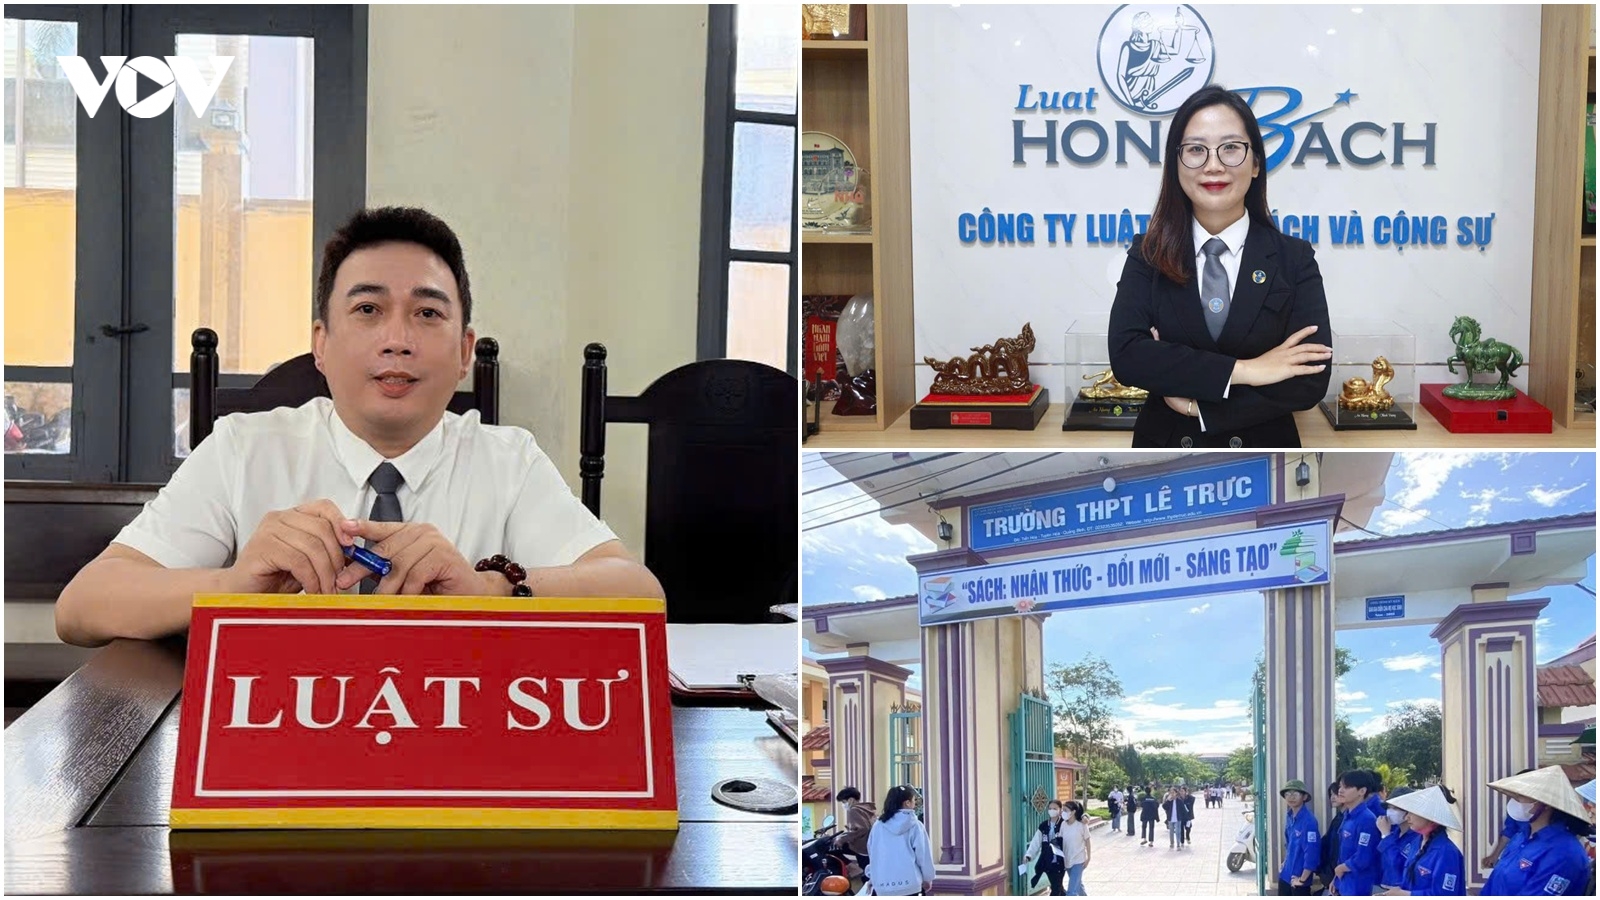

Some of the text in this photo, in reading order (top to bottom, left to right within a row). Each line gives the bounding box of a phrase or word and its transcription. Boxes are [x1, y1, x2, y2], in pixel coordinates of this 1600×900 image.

[1015, 84, 1098, 110] Luat
[1012, 119, 1162, 164] HON
[958, 207, 1035, 243] CÔNG
[1043, 213, 1076, 243] TY
[1086, 208, 1151, 249] LUẬT
[1329, 209, 1364, 245] VÀ
[1373, 210, 1447, 251] CỘNG
[1456, 212, 1495, 251] SỰ
[983, 506, 1066, 538] TRƯỜNG
[1076, 495, 1133, 523] THPT
[1145, 485, 1173, 512] LÊ
[1184, 476, 1252, 506] TRỰC
[1011, 569, 1048, 600] NHẬN
[1053, 563, 1092, 594] THỨC
[1107, 553, 1134, 587] ĐỔI
[1139, 552, 1170, 584] MỚI
[1186, 548, 1231, 579] SÁNG
[223, 667, 629, 745] LUẬT SƯ
